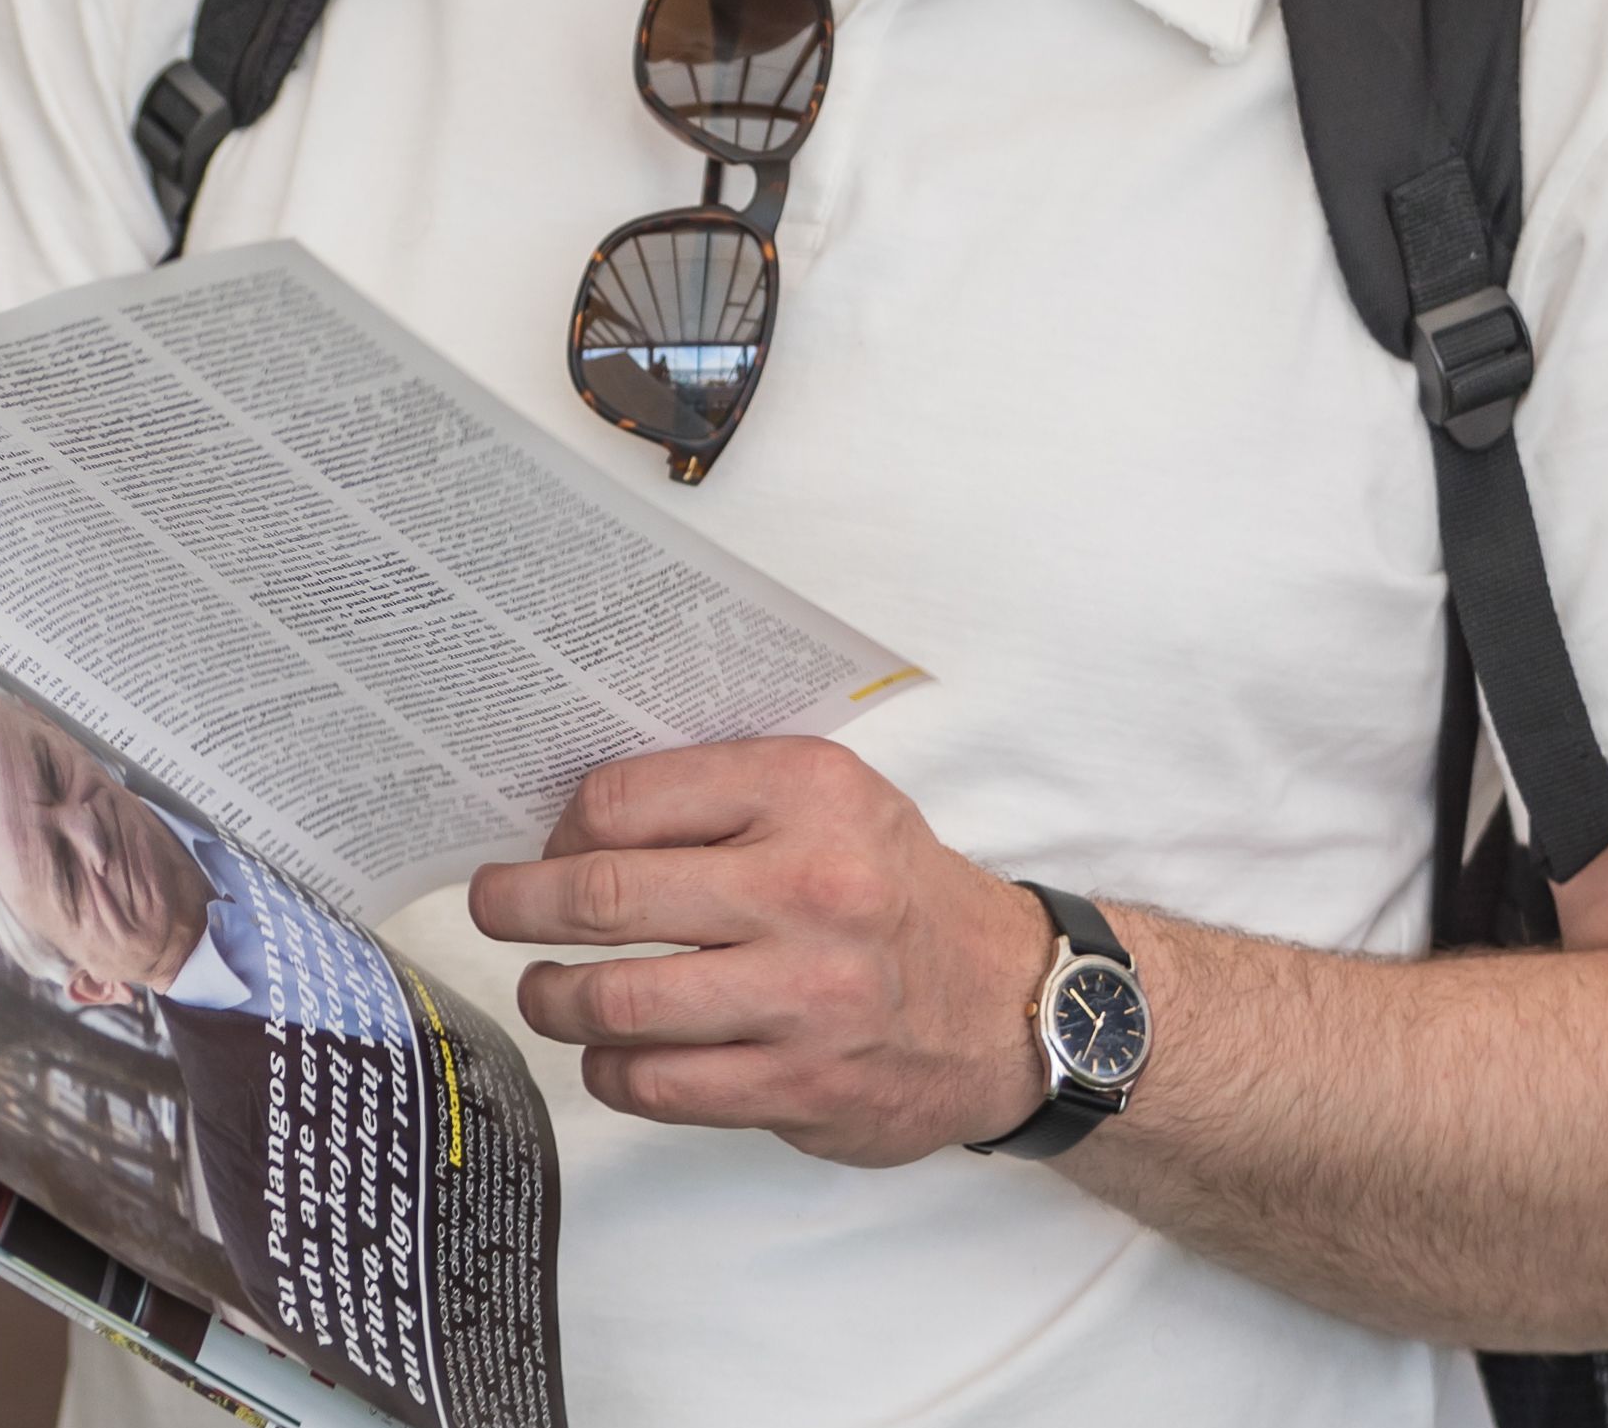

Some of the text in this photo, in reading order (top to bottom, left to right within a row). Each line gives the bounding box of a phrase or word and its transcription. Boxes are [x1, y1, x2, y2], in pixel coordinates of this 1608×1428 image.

[220, 833, 304, 1333] Su Palangos komunal
[281, 912, 333, 1347] vadu apie neregėtą
[355, 1057, 382, 1229] tualetų
[434, 1082, 448, 1179] Palangos
[440, 1038, 462, 1167] Konstantinas
[324, 1043, 372, 1375] pasiaukojantį
[358, 941, 426, 1404] eurų algą ir radinius
[448, 1170, 461, 1275] direktorius
[360, 1243, 396, 1387] triūsą,
